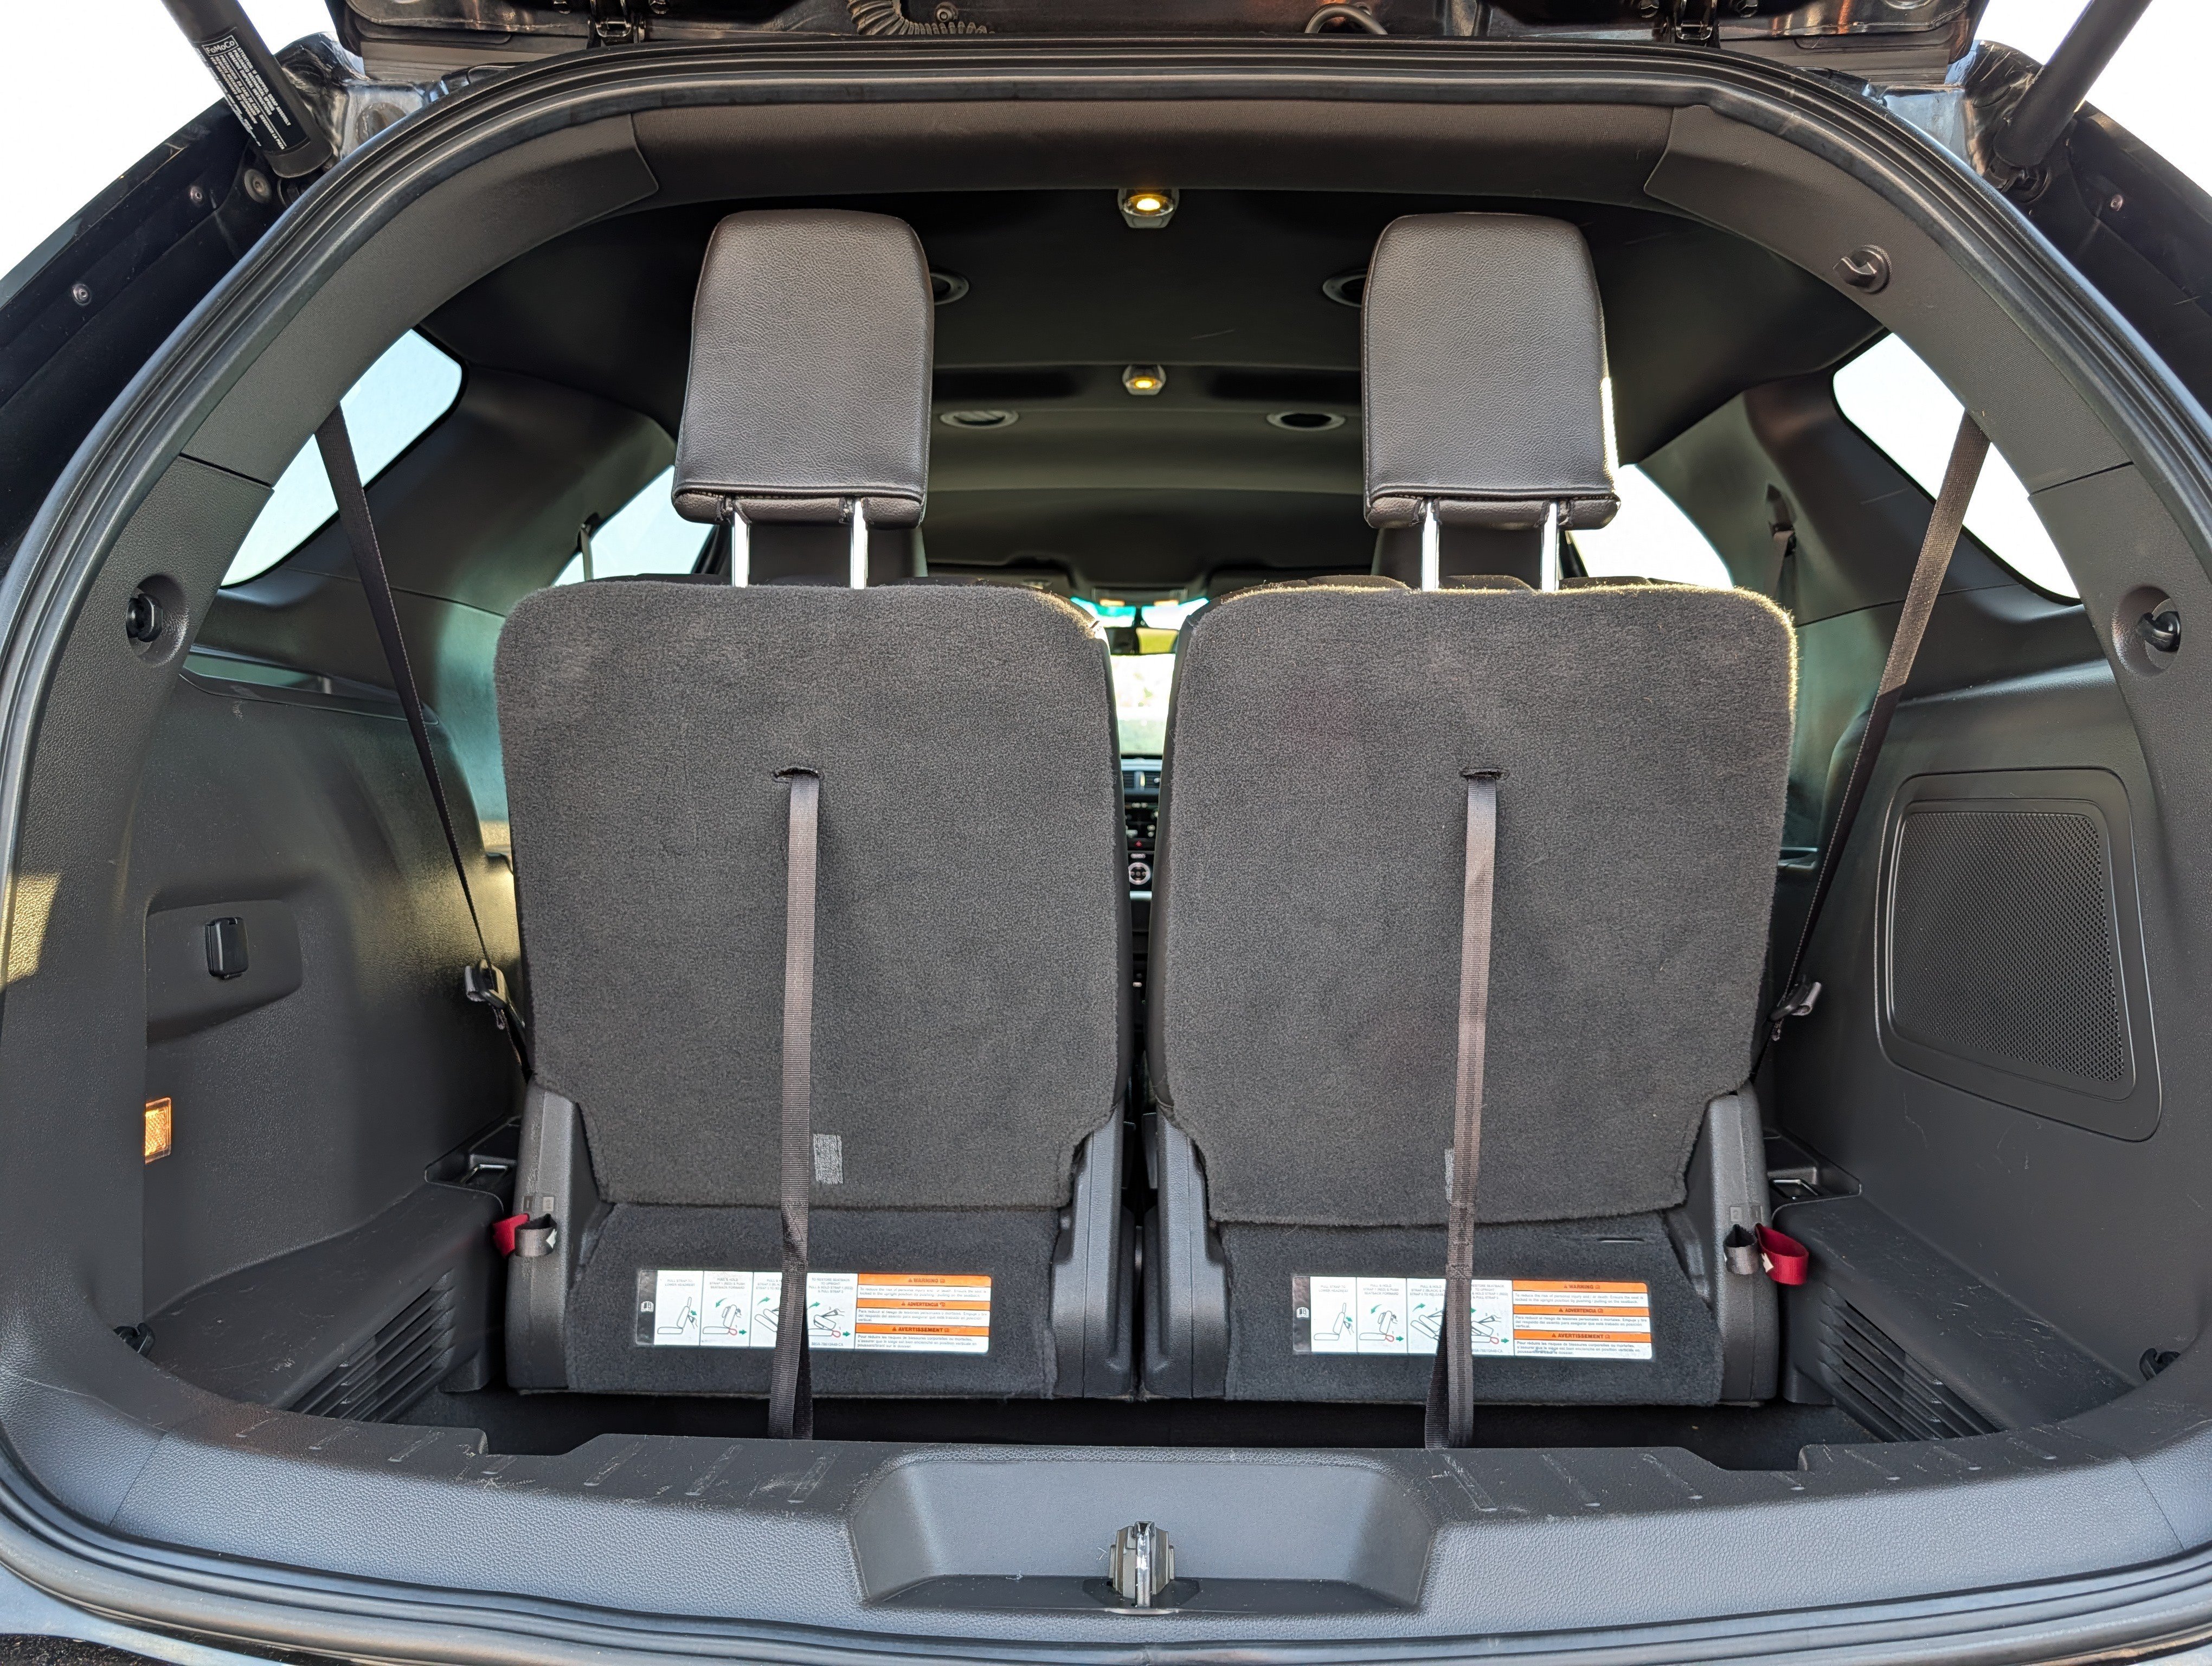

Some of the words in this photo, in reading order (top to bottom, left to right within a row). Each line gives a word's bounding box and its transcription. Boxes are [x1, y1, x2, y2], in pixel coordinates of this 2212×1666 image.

[205, 41, 235, 54] FoMoCo
[228, 52, 242, 69] OBSERVE
[240, 70, 254, 88] DISPOSAL
[252, 88, 272, 115] INSTRUCTIONS
[233, 49, 250, 73] PRELOADED
[247, 72, 265, 97] MECHANICAL
[263, 96, 275, 111] SPRING
[237, 47, 253, 70] ATTENTION:
[268, 93, 278, 106] SCRAP
[276, 106, 291, 125] ASSEMBLY
[276, 139, 285, 150] PIEZA
